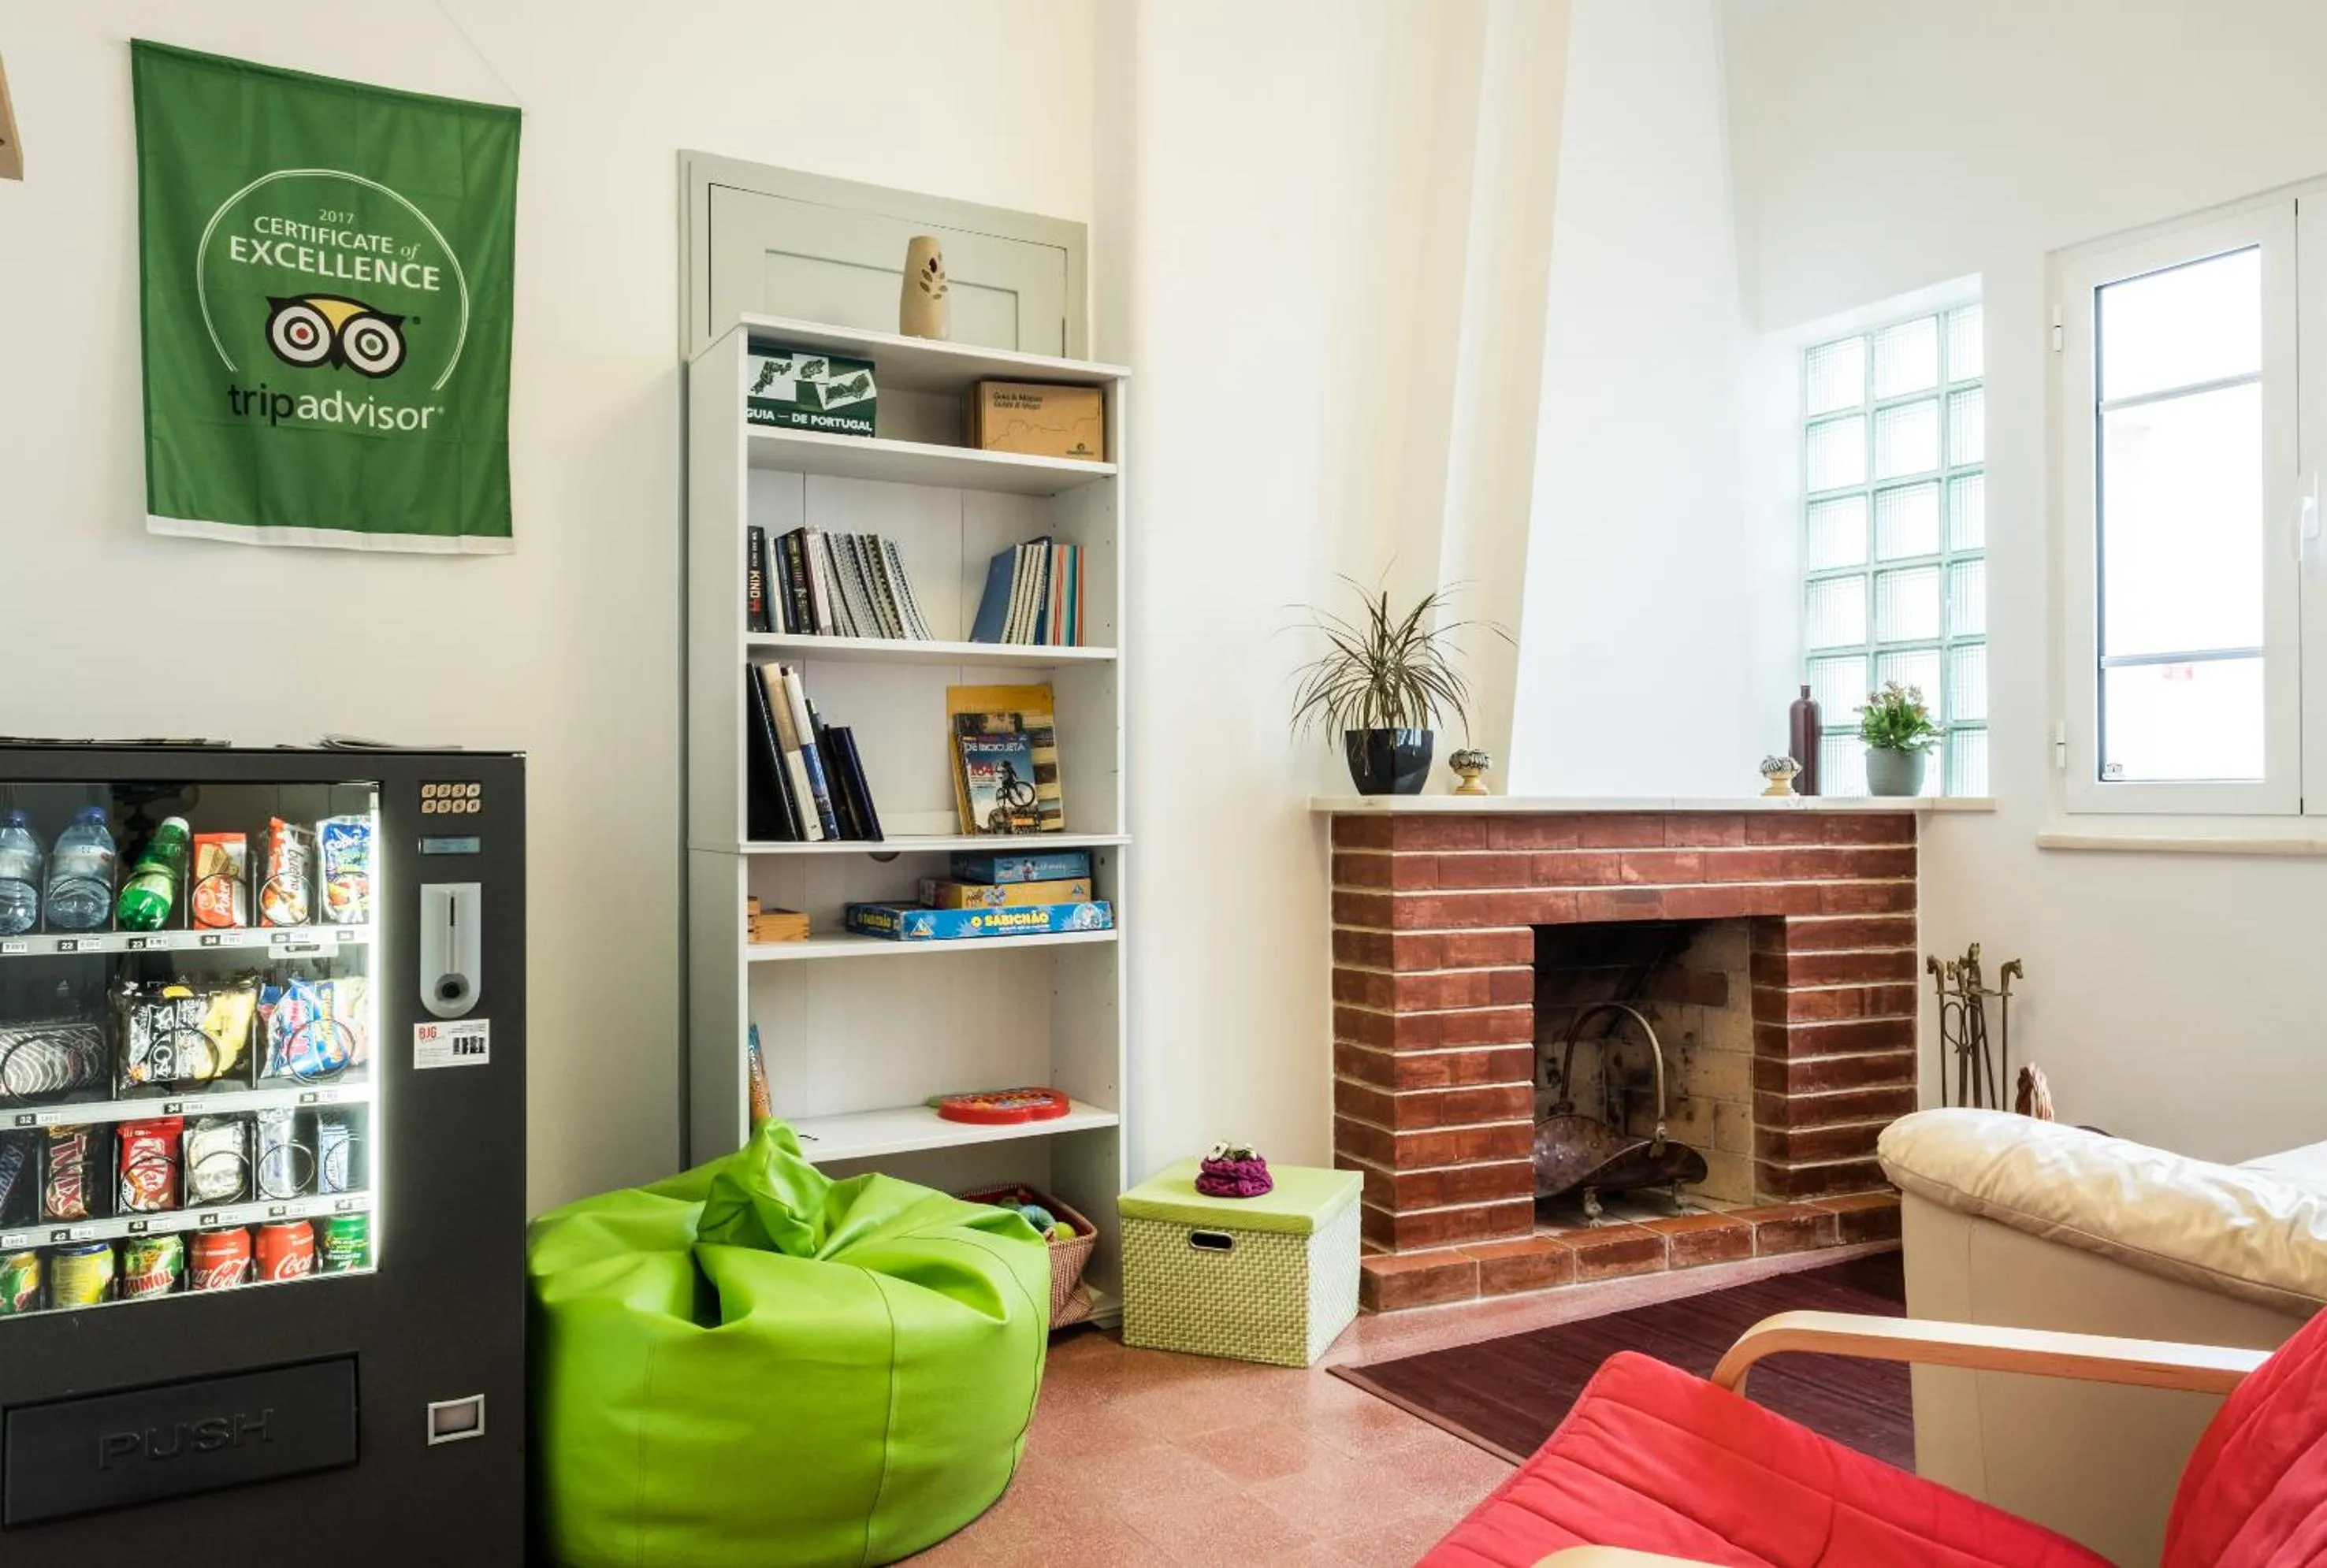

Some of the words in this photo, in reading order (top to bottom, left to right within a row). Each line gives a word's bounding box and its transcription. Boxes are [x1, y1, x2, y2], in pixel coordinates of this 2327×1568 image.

[318, 209, 355, 225] 2017
[254, 216, 393, 254] CERTIFICATE
[400, 243, 421, 261] of
[229, 235, 440, 292] EXCELLENCE
[228, 383, 435, 430] tripadvisor
[747, 408, 775, 421] GUIA
[792, 413, 808, 424] DE
[811, 415, 873, 432] PORTUGAL
[749, 570, 761, 599] KIND
[288, 849, 304, 890] bueno
[214, 879, 230, 916] Poker
[970, 916, 983, 928] O
[984, 912, 1049, 927] SABICHÃO
[50, 1134, 87, 1211] TWIX
[98, 1407, 274, 1471] PUSH
